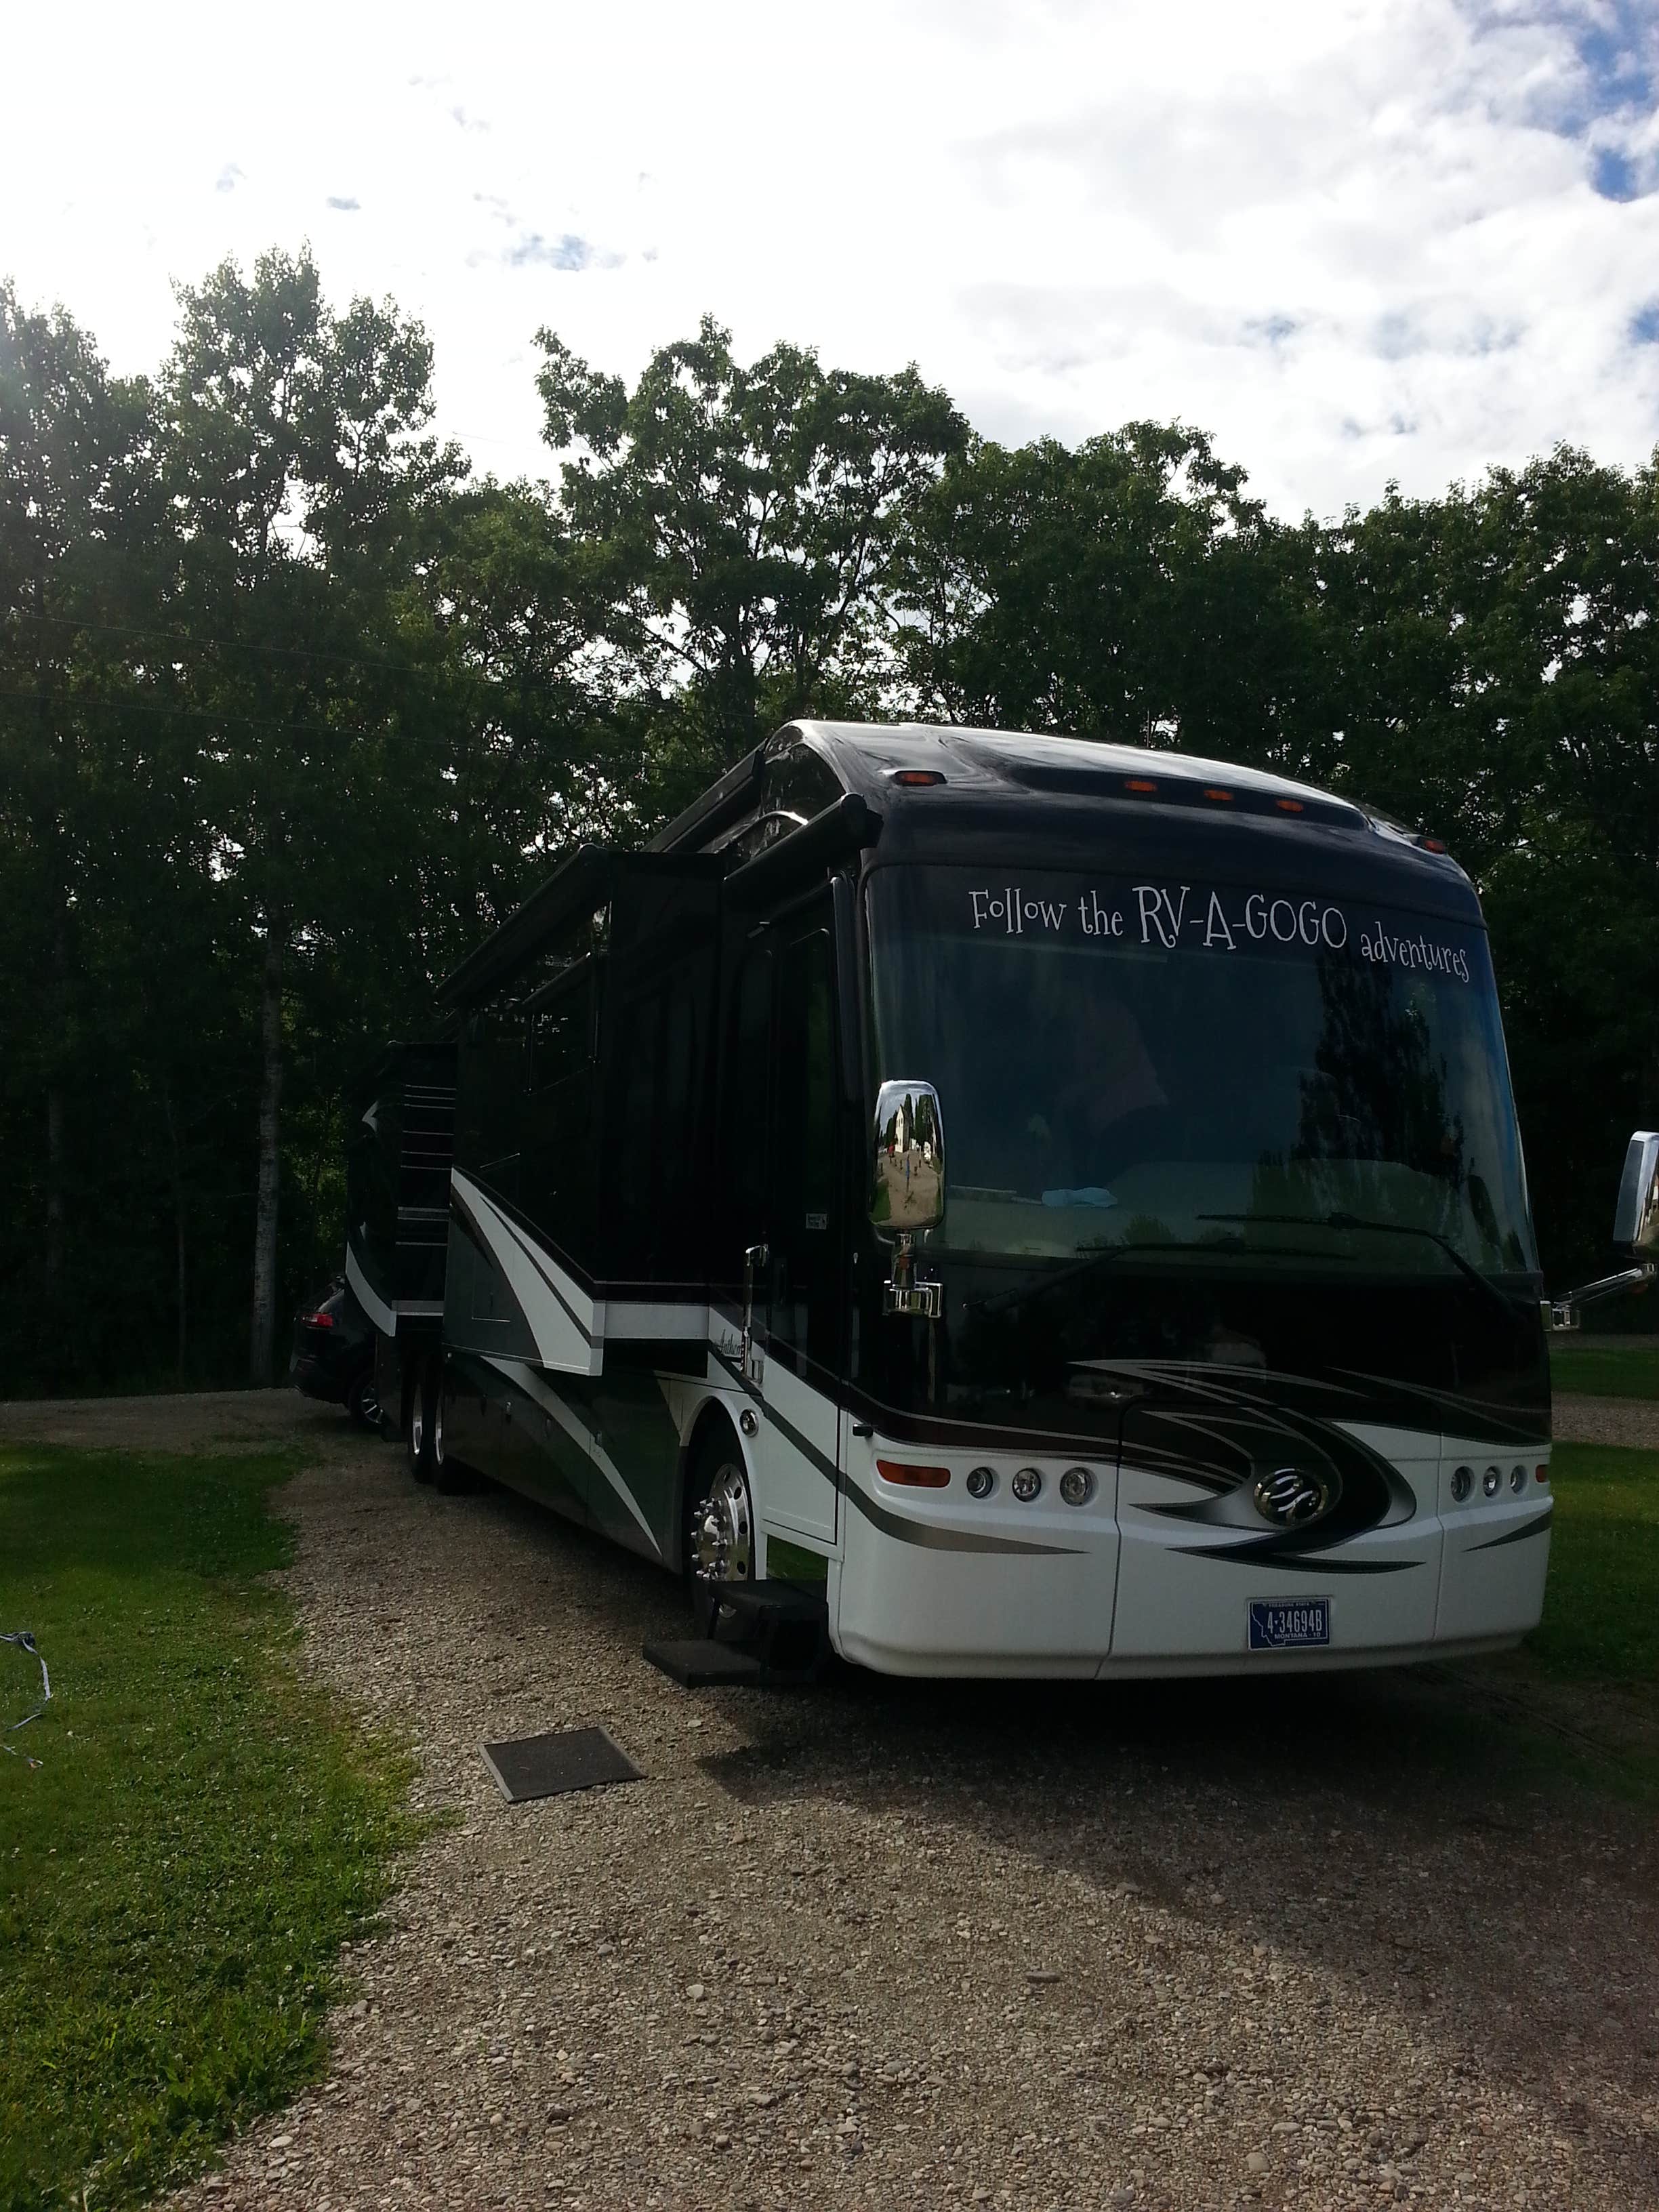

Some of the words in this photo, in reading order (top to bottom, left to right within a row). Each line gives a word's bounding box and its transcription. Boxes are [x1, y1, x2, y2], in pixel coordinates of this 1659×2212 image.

[969, 888, 1067, 935] Follow
[1078, 889, 1124, 937] the
[1132, 885, 1348, 951] RV-A-GOGO
[1359, 921, 1470, 983] adventures
